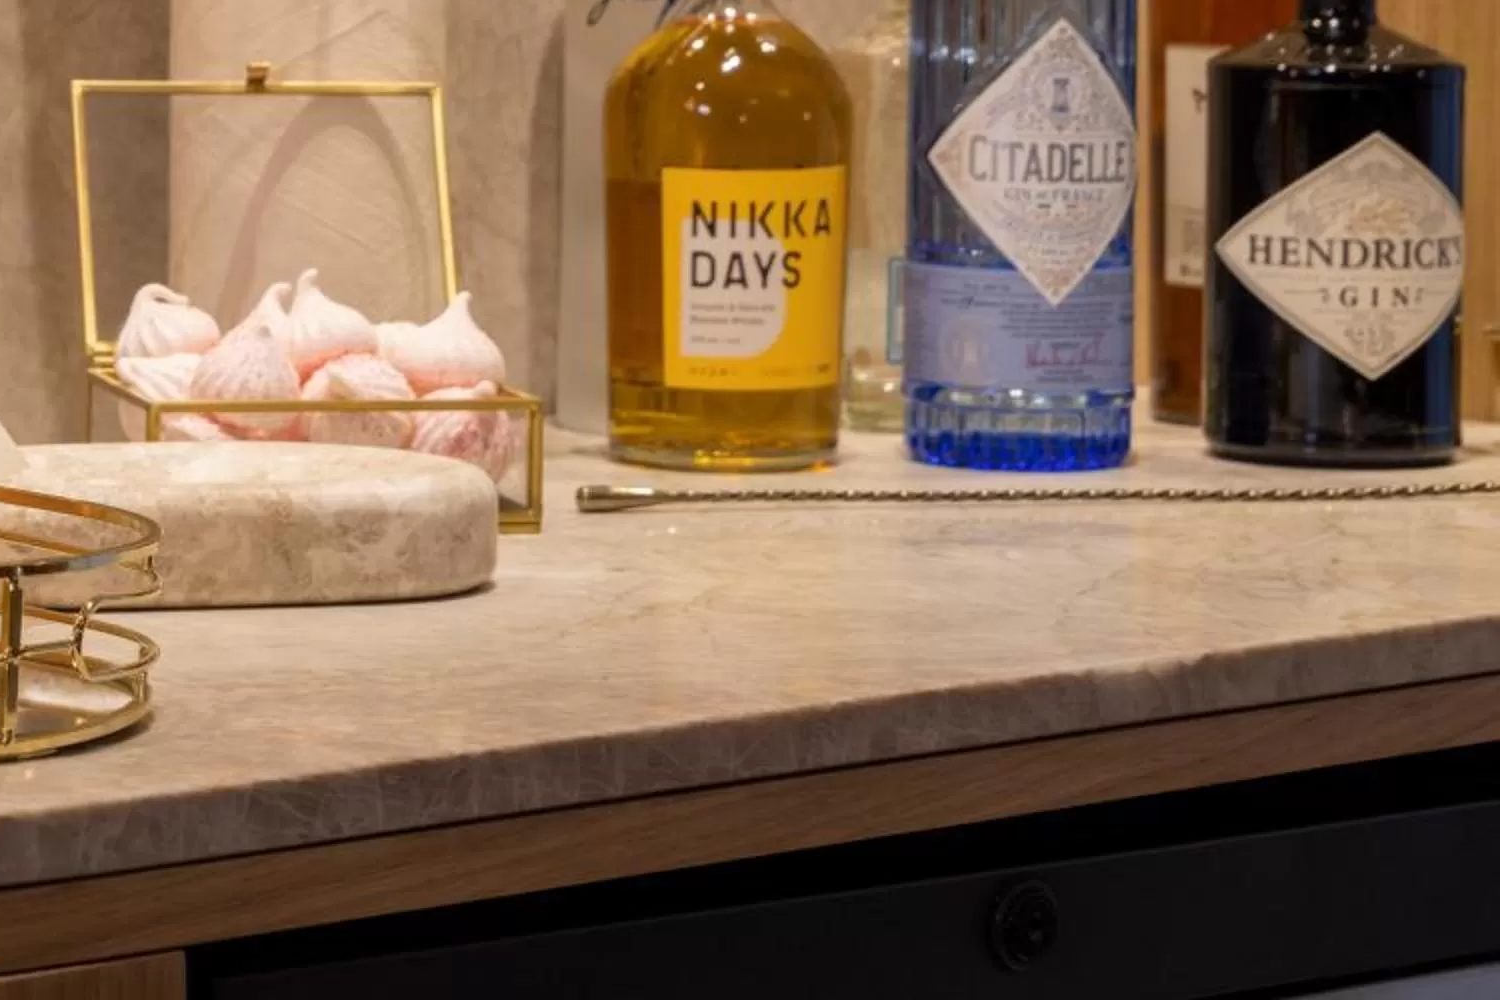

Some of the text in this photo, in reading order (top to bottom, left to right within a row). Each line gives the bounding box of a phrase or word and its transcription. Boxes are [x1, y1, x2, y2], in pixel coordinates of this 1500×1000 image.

[968, 134, 1127, 184] CITADELLE
[691, 198, 832, 239] NIKKA
[690, 251, 802, 289] DAYS
[1338, 285, 1411, 309] GIN
